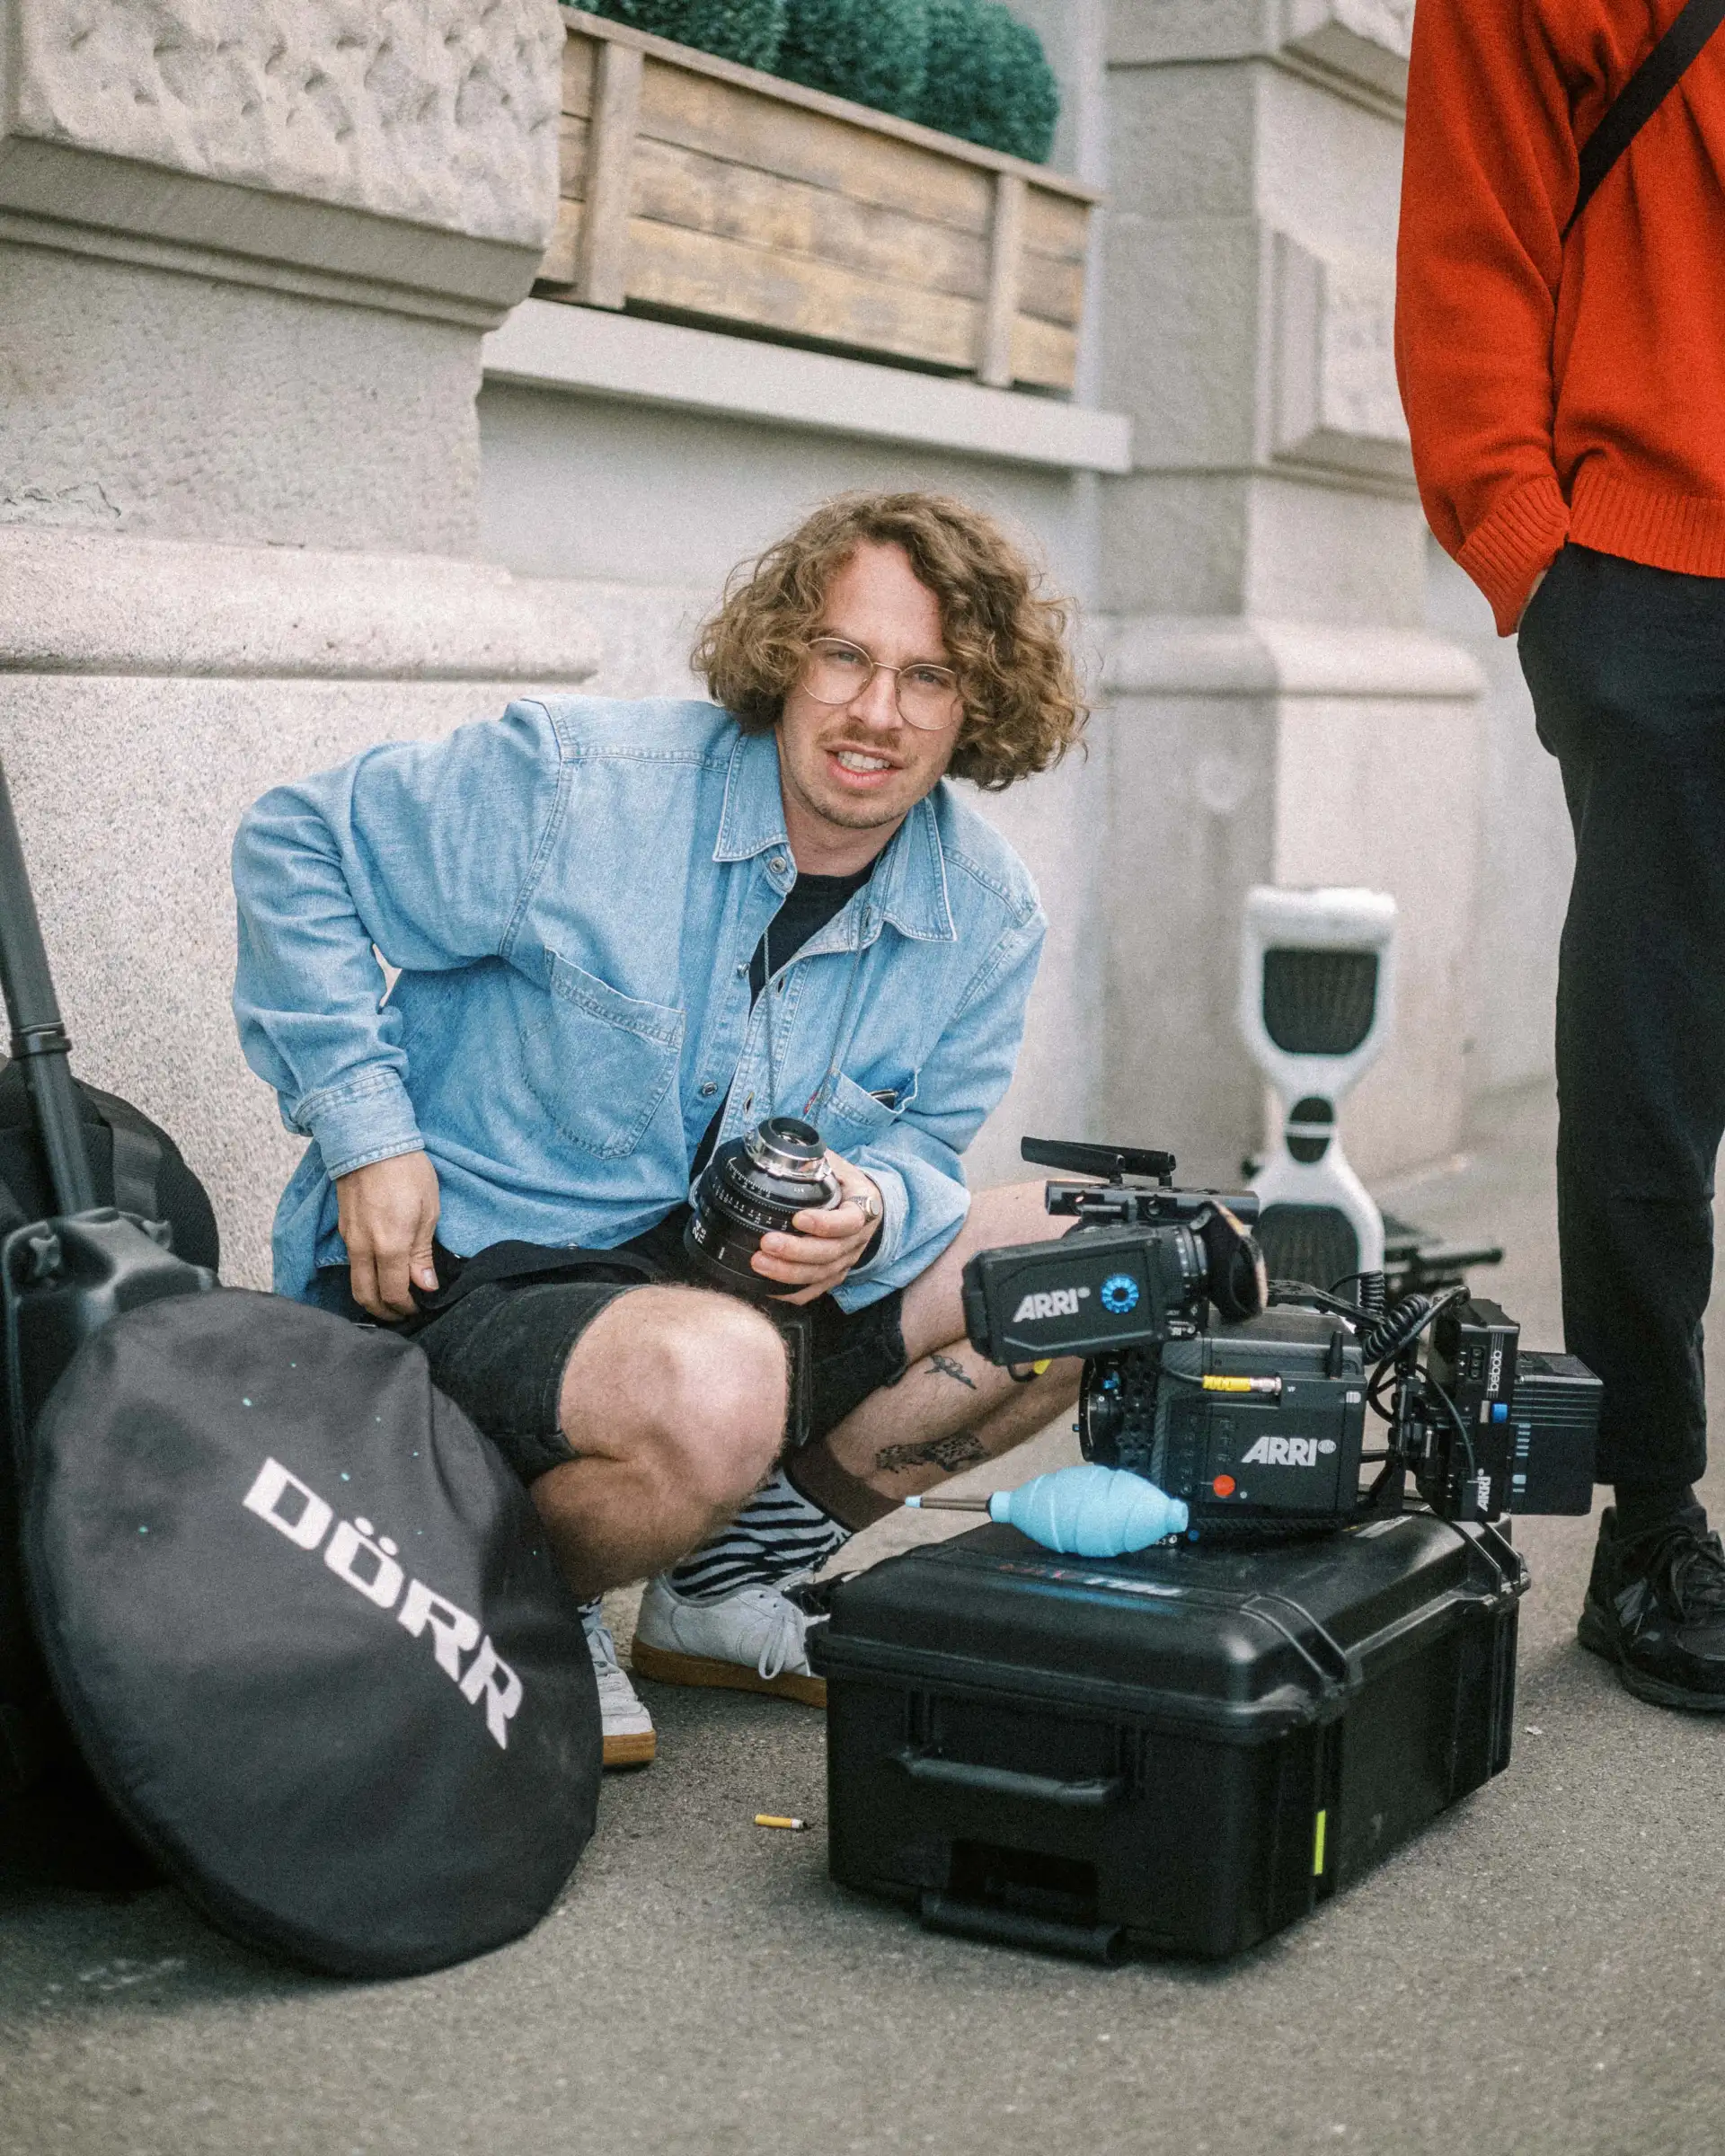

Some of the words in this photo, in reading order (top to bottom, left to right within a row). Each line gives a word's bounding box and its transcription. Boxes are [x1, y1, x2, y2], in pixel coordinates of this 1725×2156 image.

[1013, 1287, 1079, 1323] ARRI
[1488, 1350, 1503, 1392] bebob
[1241, 1436, 1318, 1466] ARRI
[1476, 1476, 1491, 1512] ARRI
[242, 1456, 523, 1750] DÖRR
